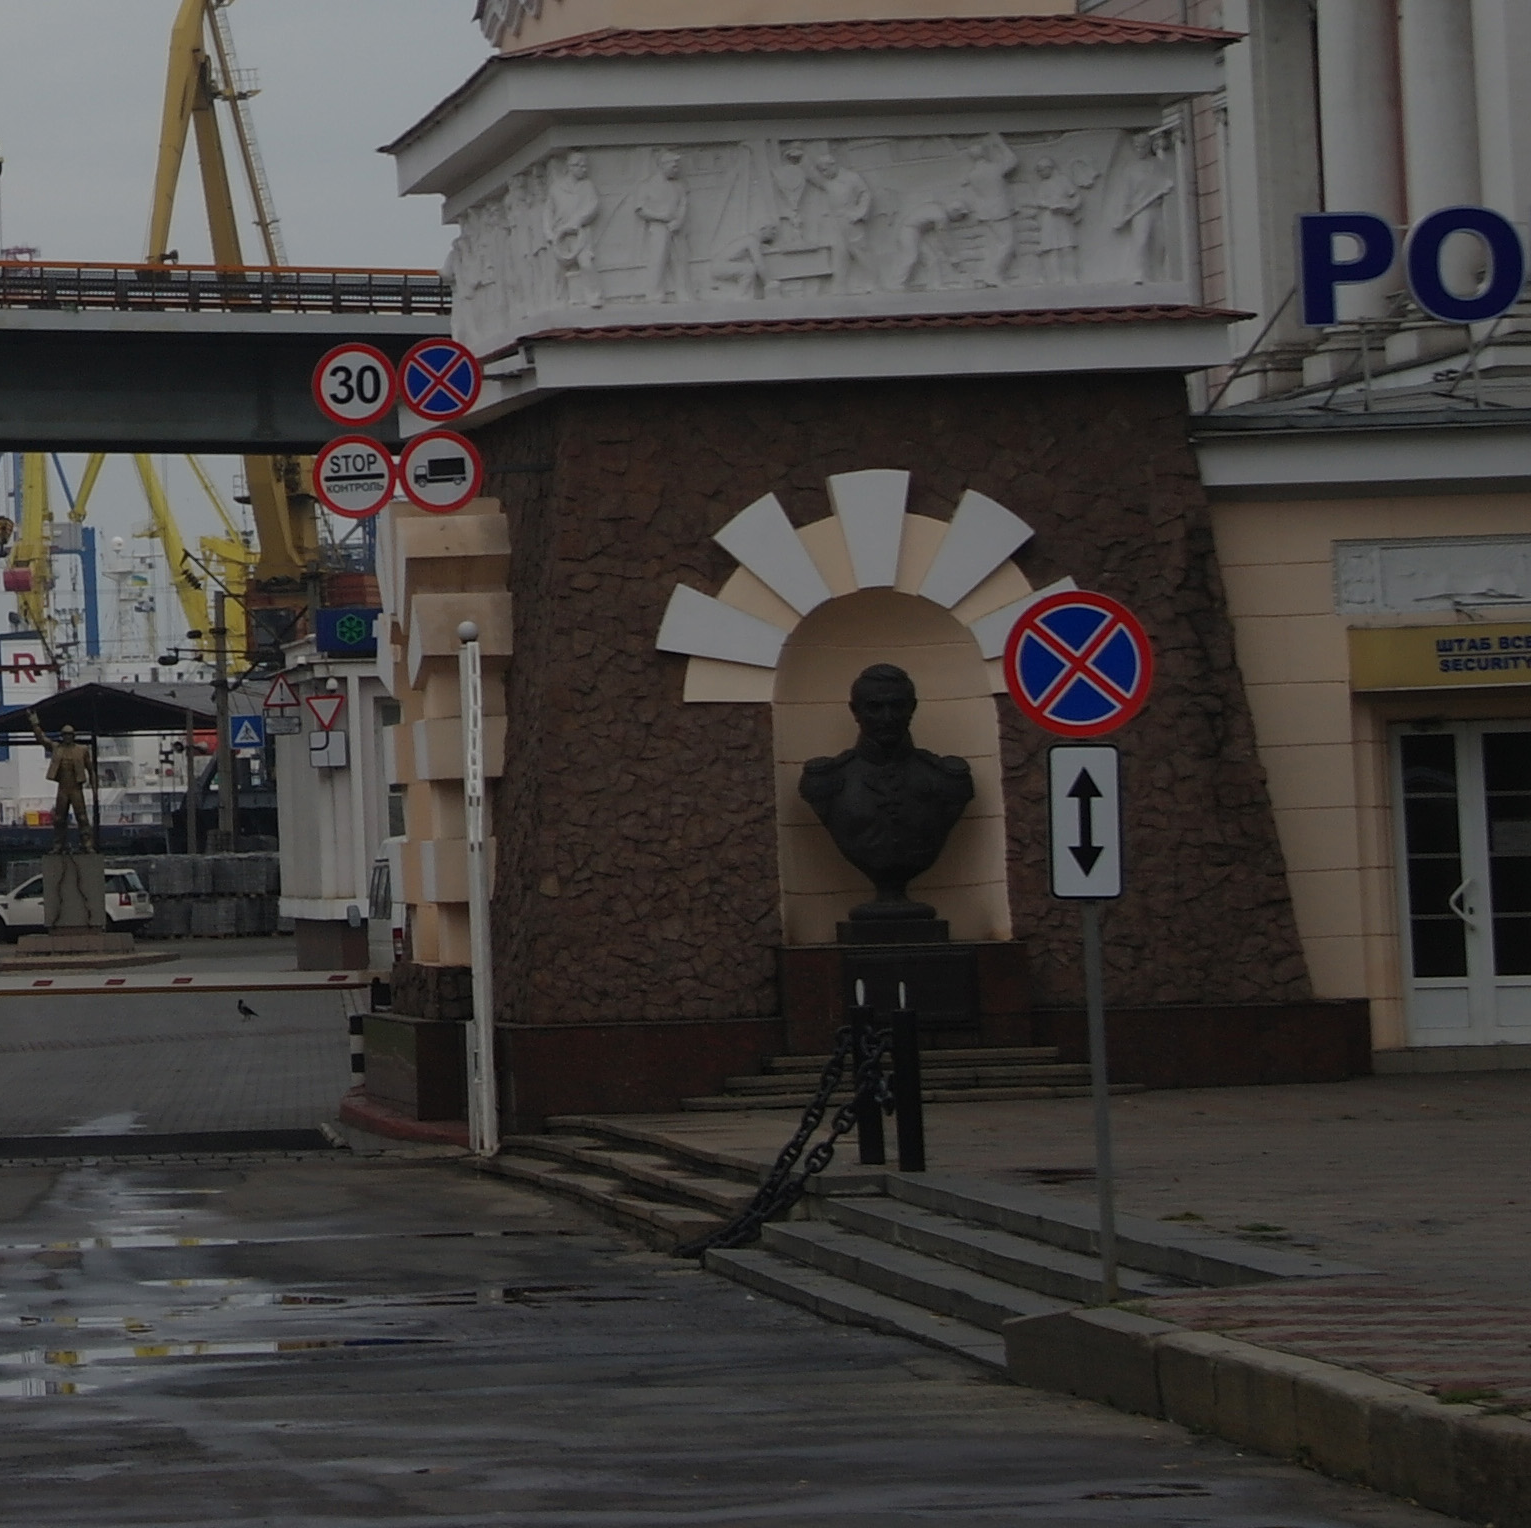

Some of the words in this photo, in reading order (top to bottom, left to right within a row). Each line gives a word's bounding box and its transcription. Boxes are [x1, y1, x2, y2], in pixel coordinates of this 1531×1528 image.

[330, 365, 381, 404] 30
[330, 453, 377, 473] STOP
[326, 481, 385, 494] КОНТРОЛЬ
[1436, 637, 1492, 652] ШТАБ
